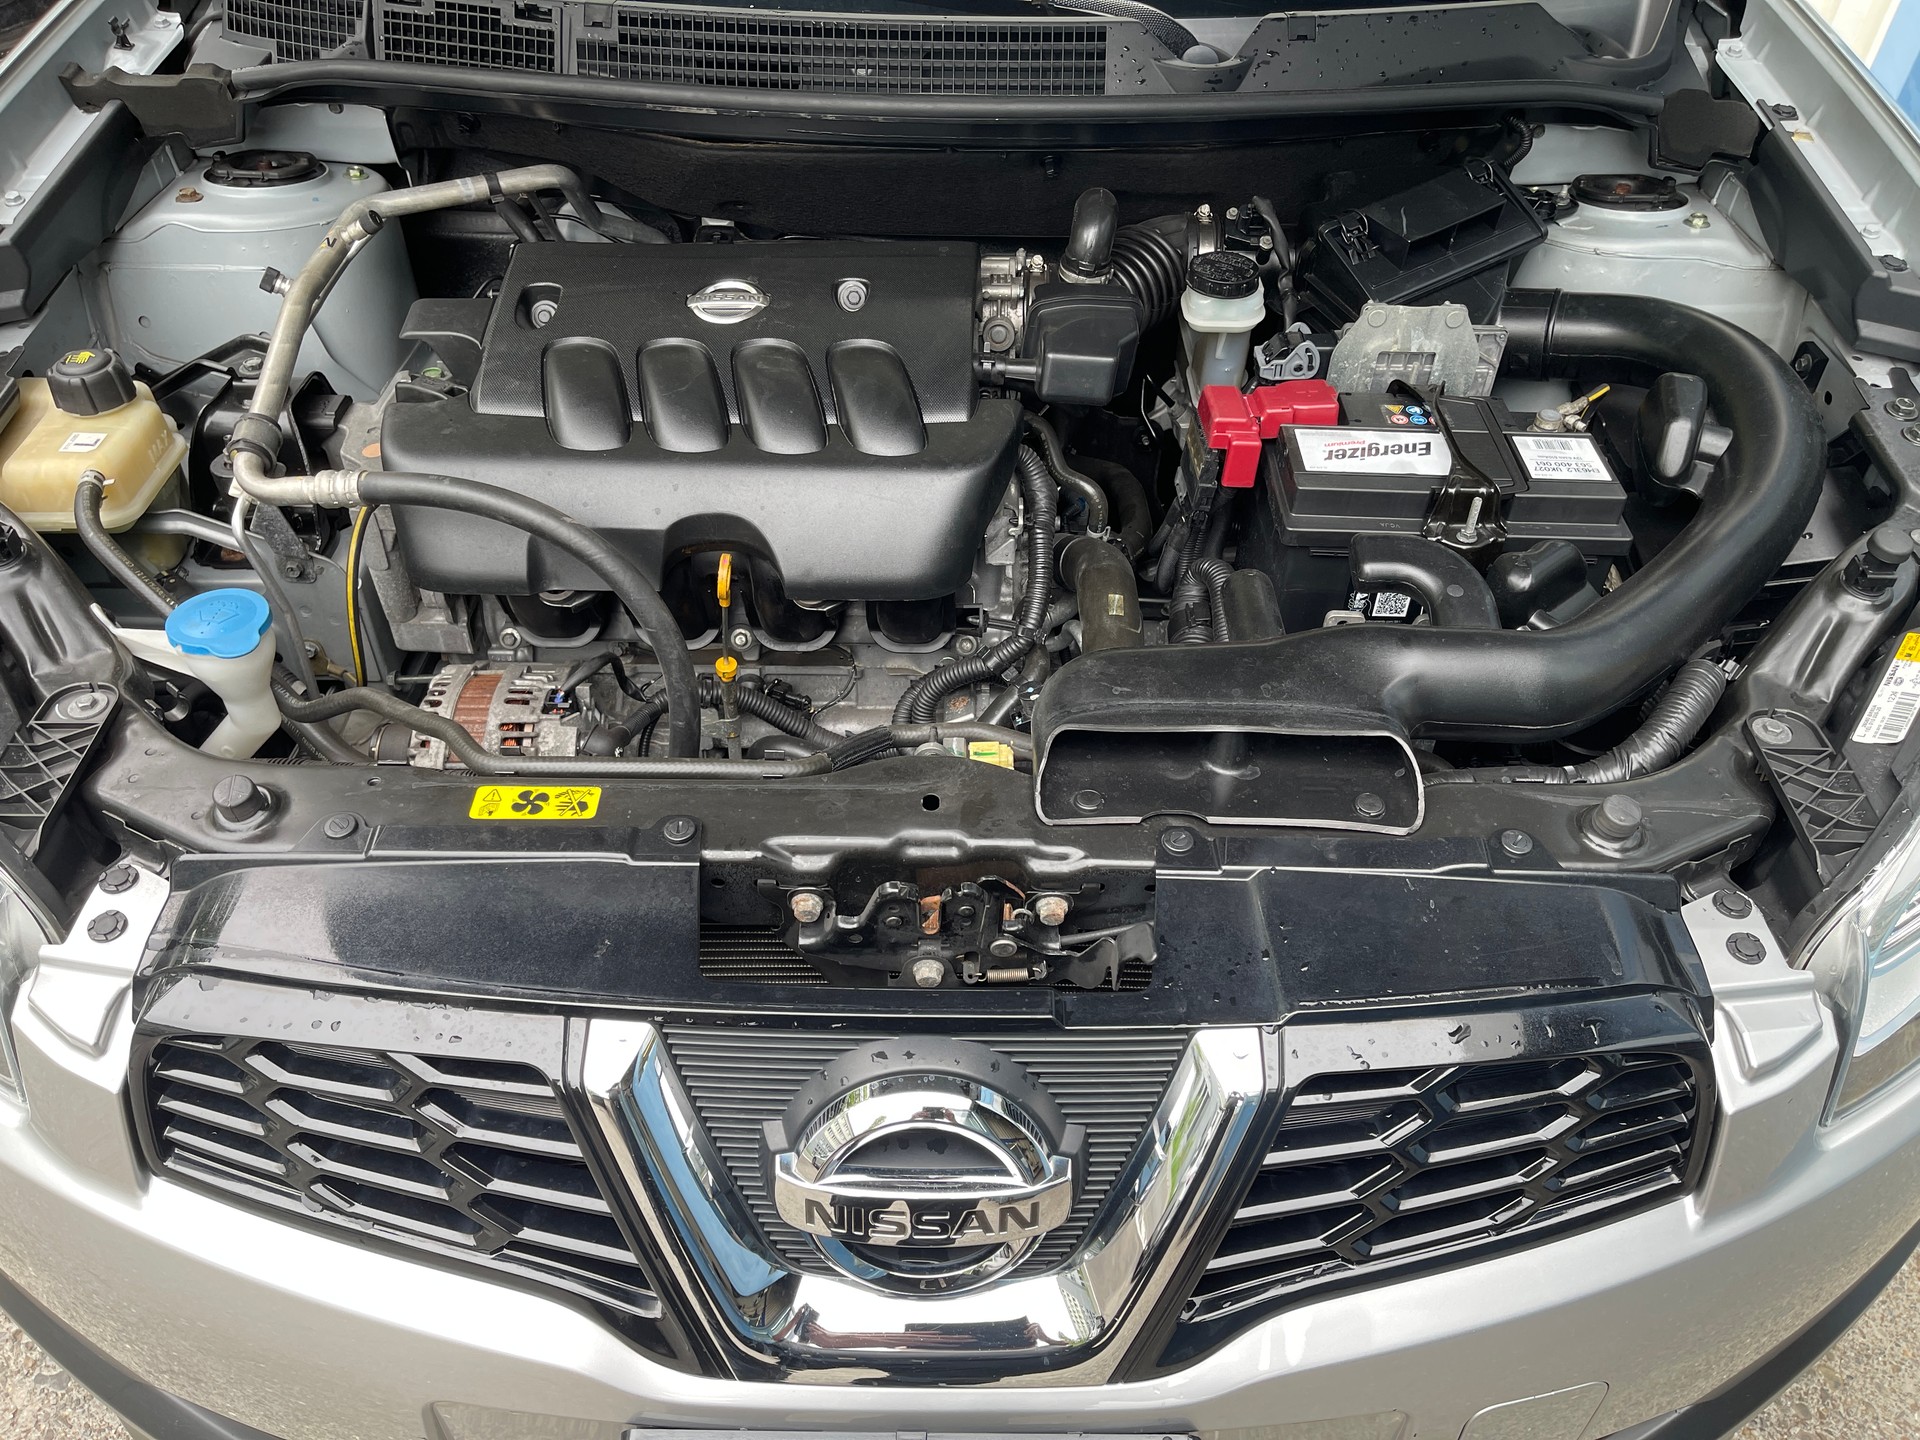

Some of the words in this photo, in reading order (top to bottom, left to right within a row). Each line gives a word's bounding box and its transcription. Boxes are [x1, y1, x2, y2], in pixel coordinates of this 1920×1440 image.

[695, 293, 761, 302] NISSAN
[1324, 439, 1366, 447] Premium
[1324, 441, 1432, 461] Energizer
[1884, 664, 1900, 686] NISSAN
[804, 1198, 1041, 1240] NISSAN
